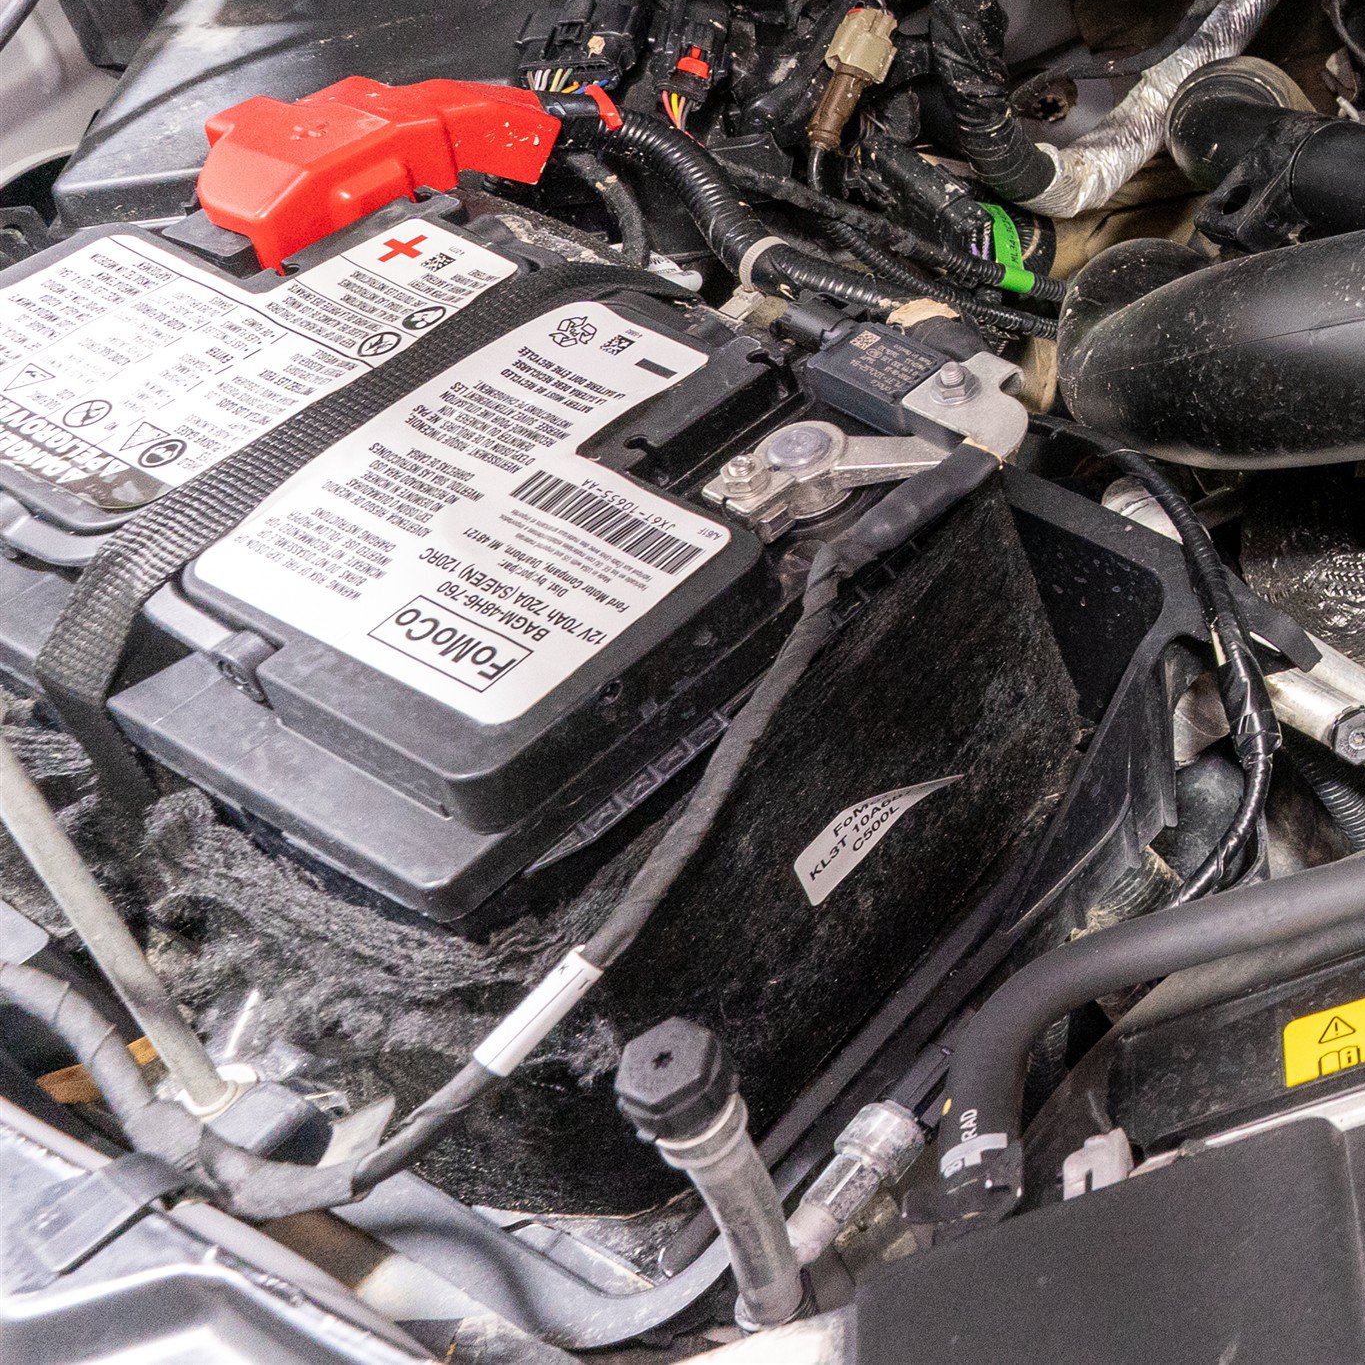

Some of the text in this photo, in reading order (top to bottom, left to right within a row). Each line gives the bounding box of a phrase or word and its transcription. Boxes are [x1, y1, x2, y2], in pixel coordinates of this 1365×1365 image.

[310, 297, 326, 306] DES
[298, 305, 314, 313] LOS
[566, 328, 579, 336] Pb
[339, 339, 356, 348] KEEP
[518, 346, 554, 369] RECYCLÉE
[512, 359, 553, 383] RECICLARSE
[551, 365, 571, 378] ÊTRE
[551, 380, 572, 392] DEBE
[568, 374, 587, 385] DOIT
[450, 381, 468, 394] LES
[501, 369, 593, 413] BATTERY MUST BE RECYCLED
[584, 381, 616, 397] BATTERIE
[569, 388, 597, 402] BATERÍA
[440, 391, 481, 413] UTILISATION
[464, 393, 514, 415] ATTENTIVEMENT
[514, 401, 528, 409] DE
[413, 405, 431, 417] PAS
[438, 406, 455, 416] NON
[477, 409, 495, 419] UNE
[524, 406, 572, 428] INSTRUCTIONS
[427, 414, 441, 423] NE
[491, 416, 511, 428] POUR
[511, 411, 538, 426] SUIVEZ
[487, 427, 502, 437] OU
[442, 436, 468, 451] RISQUE
[471, 434, 485, 444] DE
[482, 438, 495, 448] OU
[369, 443, 421, 473] INSTRUCCIONES
[427, 457, 441, 467] DE
[418, 468, 435, 478] LAS
[436, 462, 474, 481] CORRECTAS
[369, 459, 459, 504] NO RECOMENDADO PARA USO
[431, 475, 449, 486] SIGA
[391, 485, 402, 493] NI
[350, 495, 366, 505] DE
[388, 499, 400, 508] O
[398, 489, 434, 508] DESMONTE
[582, 479, 675, 529] JX6T-10655-AA
[360, 501, 388, 517] RIESGO
[429, 502, 443, 512] NO
[265, 518, 280, 528] FOR
[287, 513, 314, 529] PROPER
[257, 530, 272, 538] OR
[280, 524, 329, 552] RECOMMENDED
[314, 524, 341, 542] FOLLOW
[272, 535, 316, 561] DISASSEMBLE
[358, 531, 396, 552] CHARGING
[246, 539, 284, 562] EXPLOSION
[327, 549, 345, 559] NOT
[356, 546, 391, 565] INVERTED
[311, 558, 329, 567] NOT
[325, 563, 342, 573] DO
[580, 564, 593, 573] USA
[297, 567, 313, 575] OF
[463, 528, 629, 613] Ford Motor Company, Dearborn, MI 48121
[309, 571, 325, 584] RISK
[419, 547, 607, 645] 12V 70Ah 720A (SAE/EN) 120RC
[547, 582, 568, 597] Dist.
[438, 582, 548, 640] BAGM-48H6-760
[396, 609, 514, 679] FoMoCo
[852, 806, 900, 852] C500L
[809, 834, 848, 881] KL3T
[958, 1107, 980, 1147] RAD
